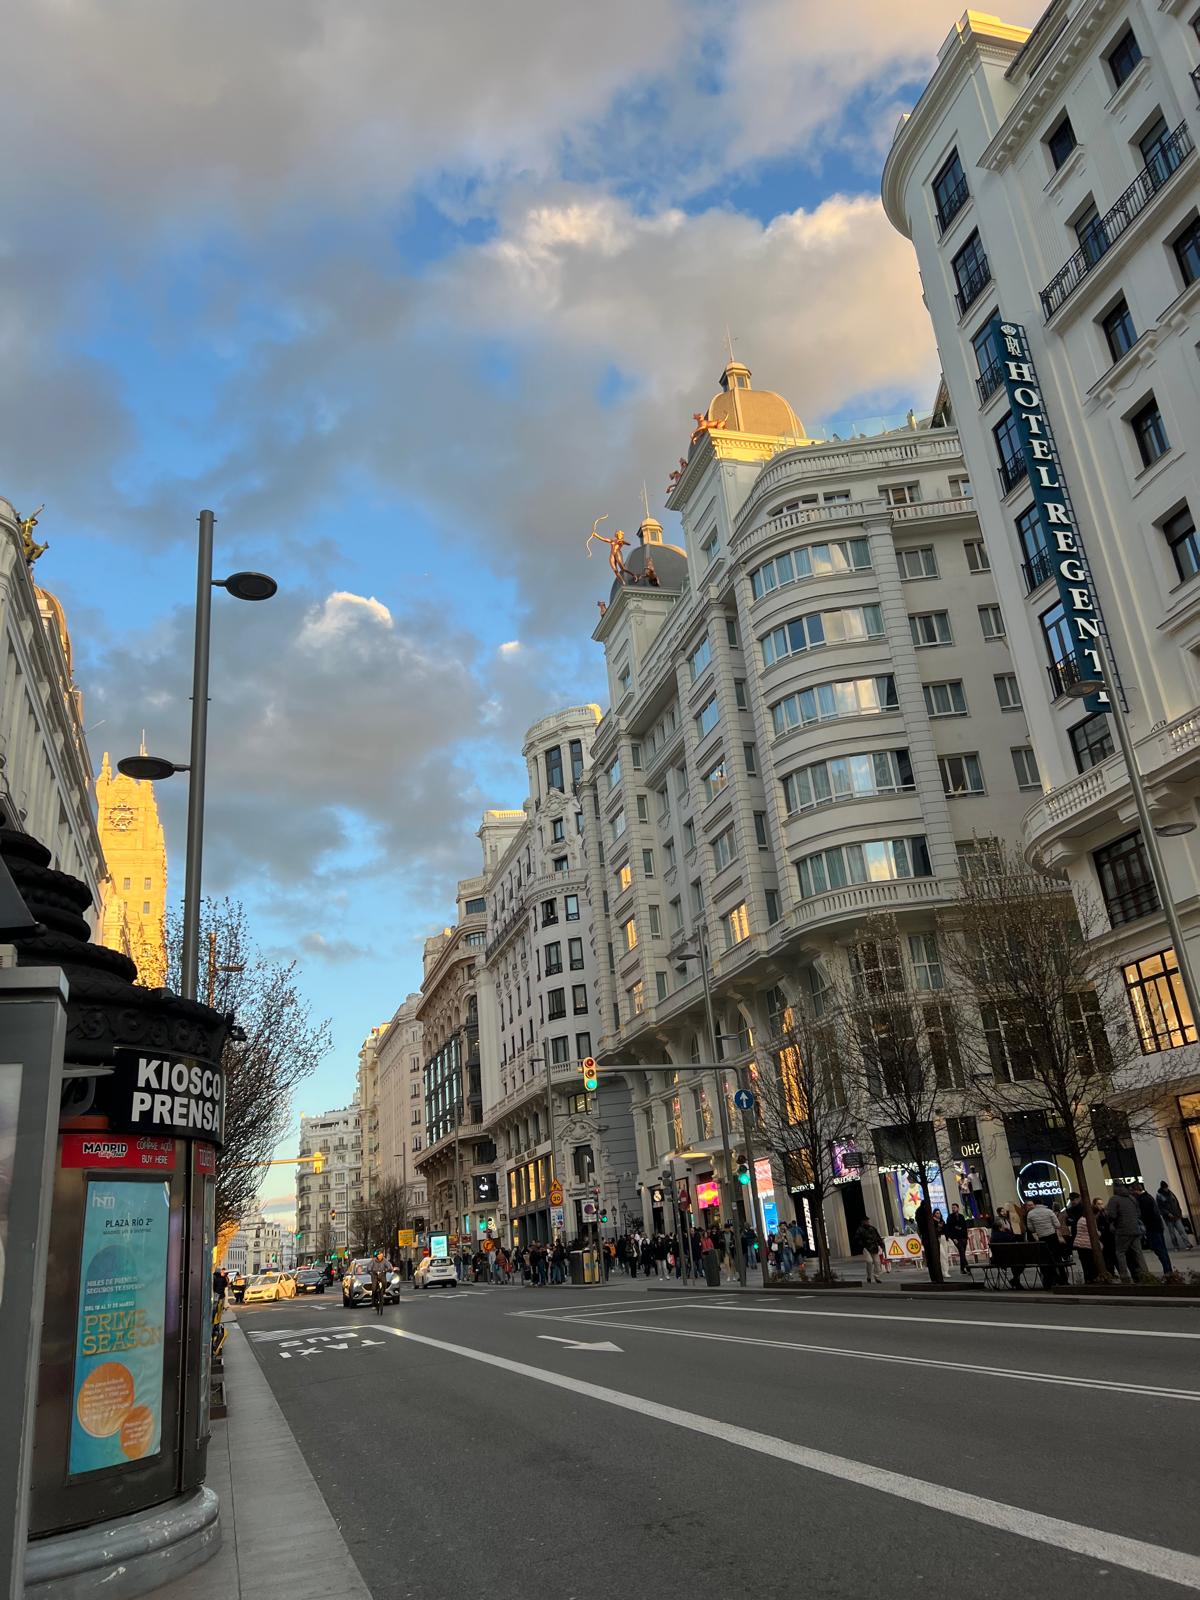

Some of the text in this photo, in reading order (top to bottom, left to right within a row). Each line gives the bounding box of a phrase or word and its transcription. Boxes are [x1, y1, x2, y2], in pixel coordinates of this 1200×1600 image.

[1005, 361, 1060, 488] HOTEL
[137, 1058, 220, 1101] KIOSCO
[131, 1091, 220, 1133] PRENSA
[83, 1143, 128, 1154] MADRID
[142, 1154, 168, 1164] BUY HERE
[105, 1219, 129, 1228] PLAZA
[132, 1217, 144, 1227] RÍO
[84, 1308, 146, 1335] PRIME
[83, 1326, 162, 1356] SEASON
[279, 1340, 386, 1358] TAXI
